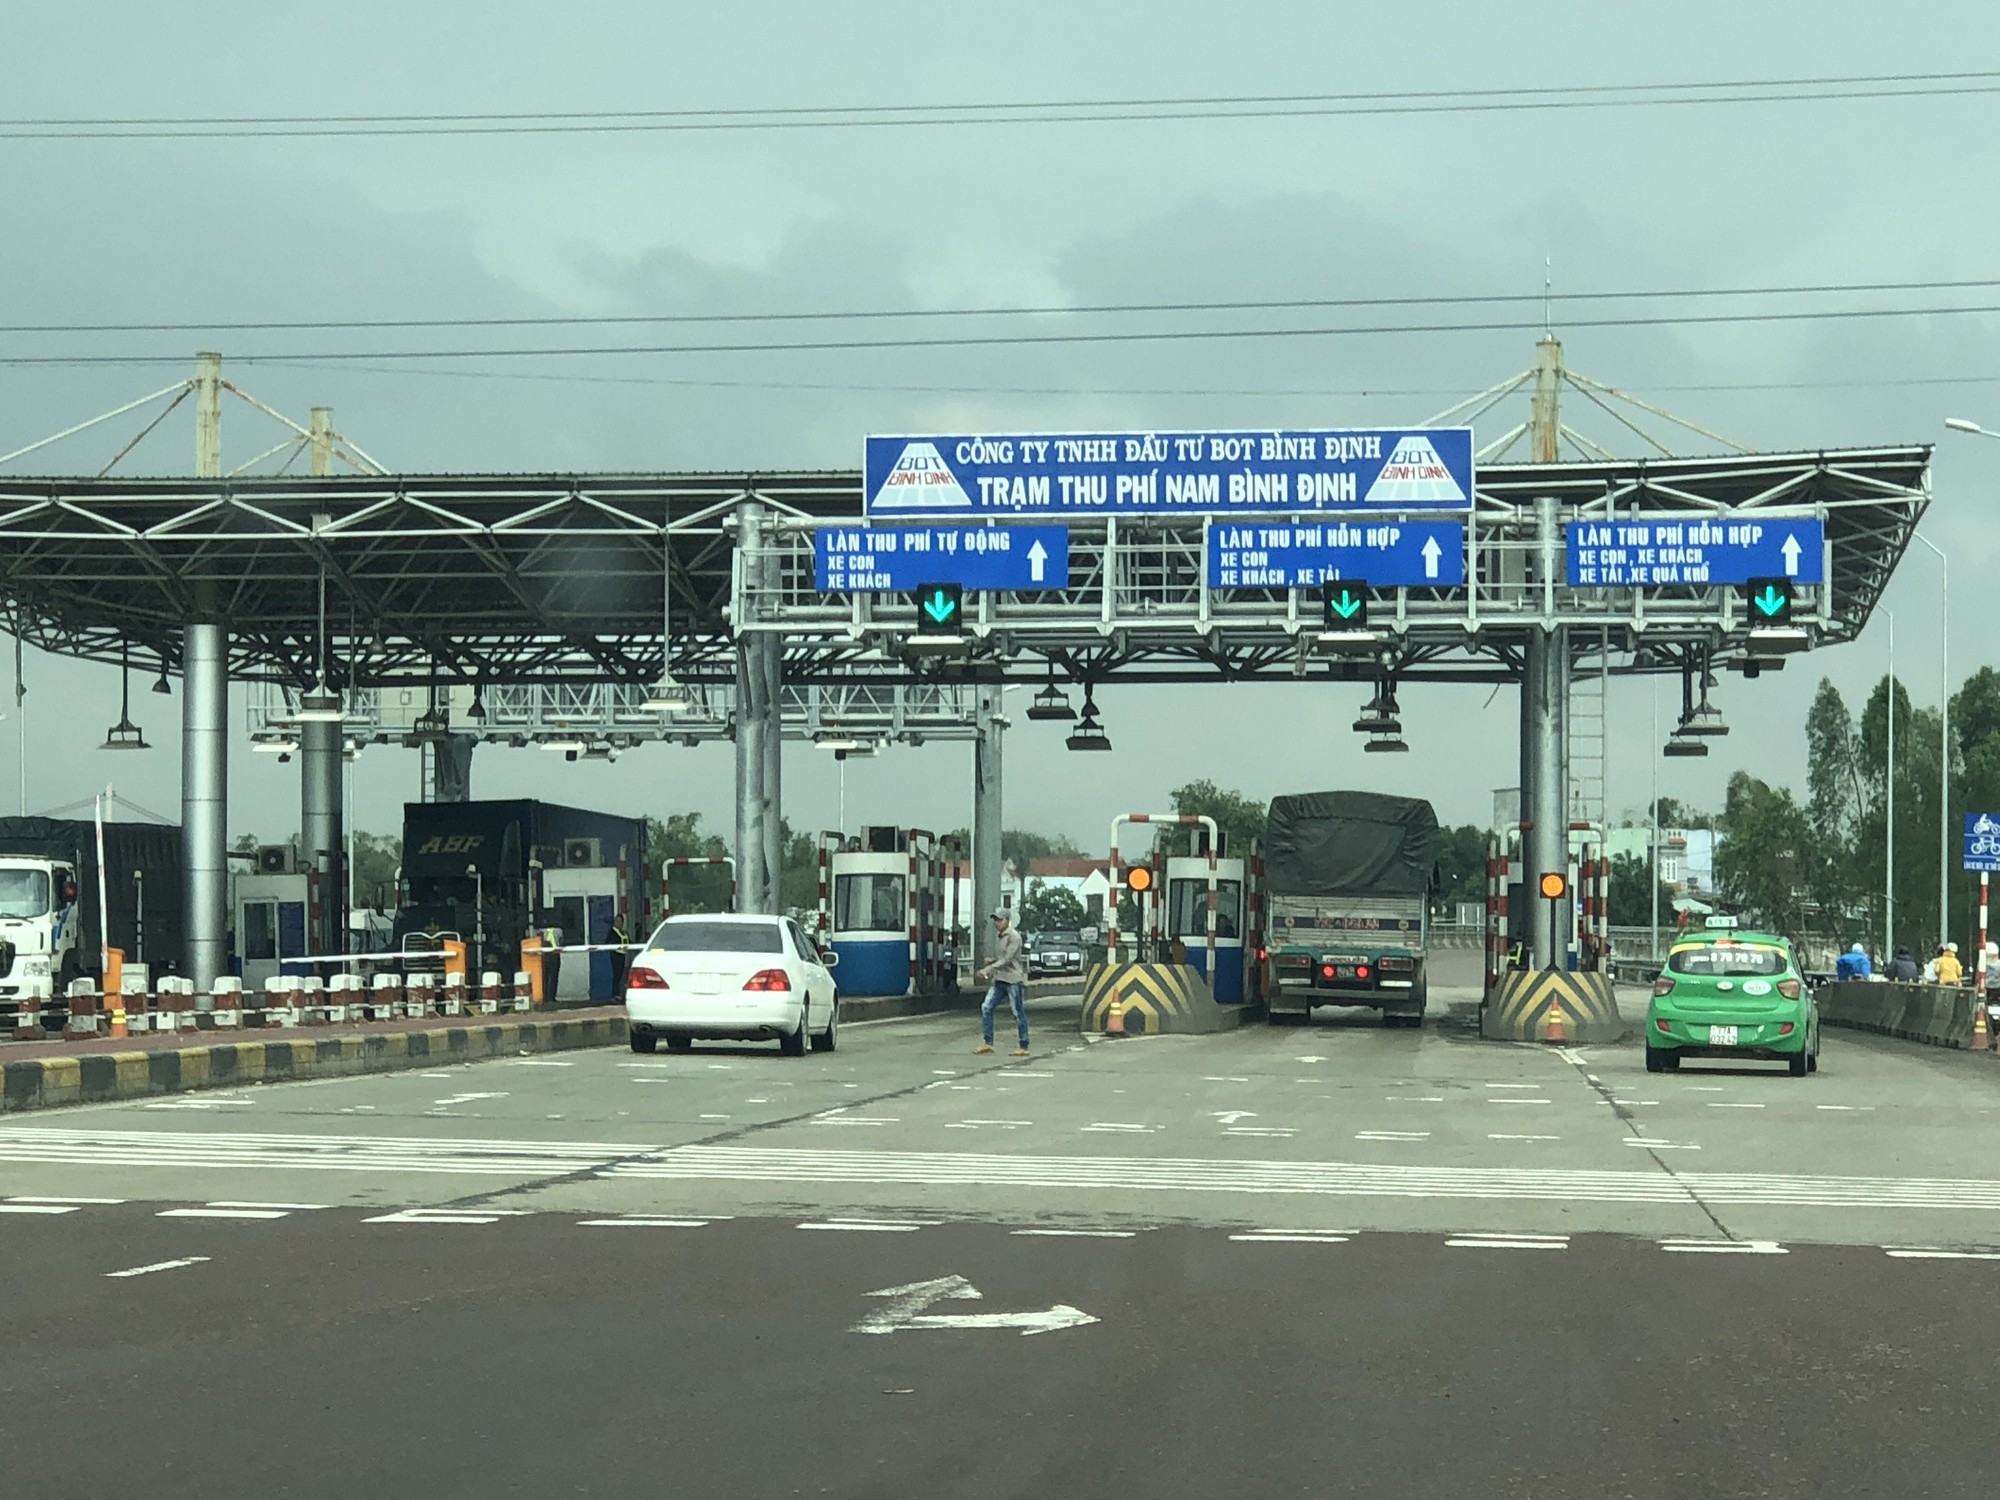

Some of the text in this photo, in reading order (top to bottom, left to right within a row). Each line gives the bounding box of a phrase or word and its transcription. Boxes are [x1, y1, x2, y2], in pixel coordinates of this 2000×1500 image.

[956, 432, 1381, 464] CÔNG TY TNHH ĐẦU TƯ BOT BÌNH ĐỊNH
[1390, 450, 1434, 464] BOT
[896, 456, 941, 470] BOT
[977, 468, 1356, 511] TRẠM THU PHÍ NAM BÌNH ĐỊNH
[827, 529, 1010, 556] LÀN THU PHÍ TỰ ĐỘNG
[1220, 523, 1401, 551] LÀN THU PHÍ HỖN HỢP
[1578, 521, 1763, 549] LÀN THU PHÍ HỖN HỢP
[828, 556, 875, 570] XE CON
[1220, 552, 1268, 567] XE CON
[1579, 550, 1596, 565] XE
[1638, 549, 1655, 564] XE
[828, 570, 891, 588] XE KHÁCH
[1220, 570, 1237, 586] XE
[1297, 569, 1314, 584] XE
[1579, 568, 1596, 583] XE
[1631, 567, 1648, 583] XE
[1652, 564, 1679, 584] QUÁ
